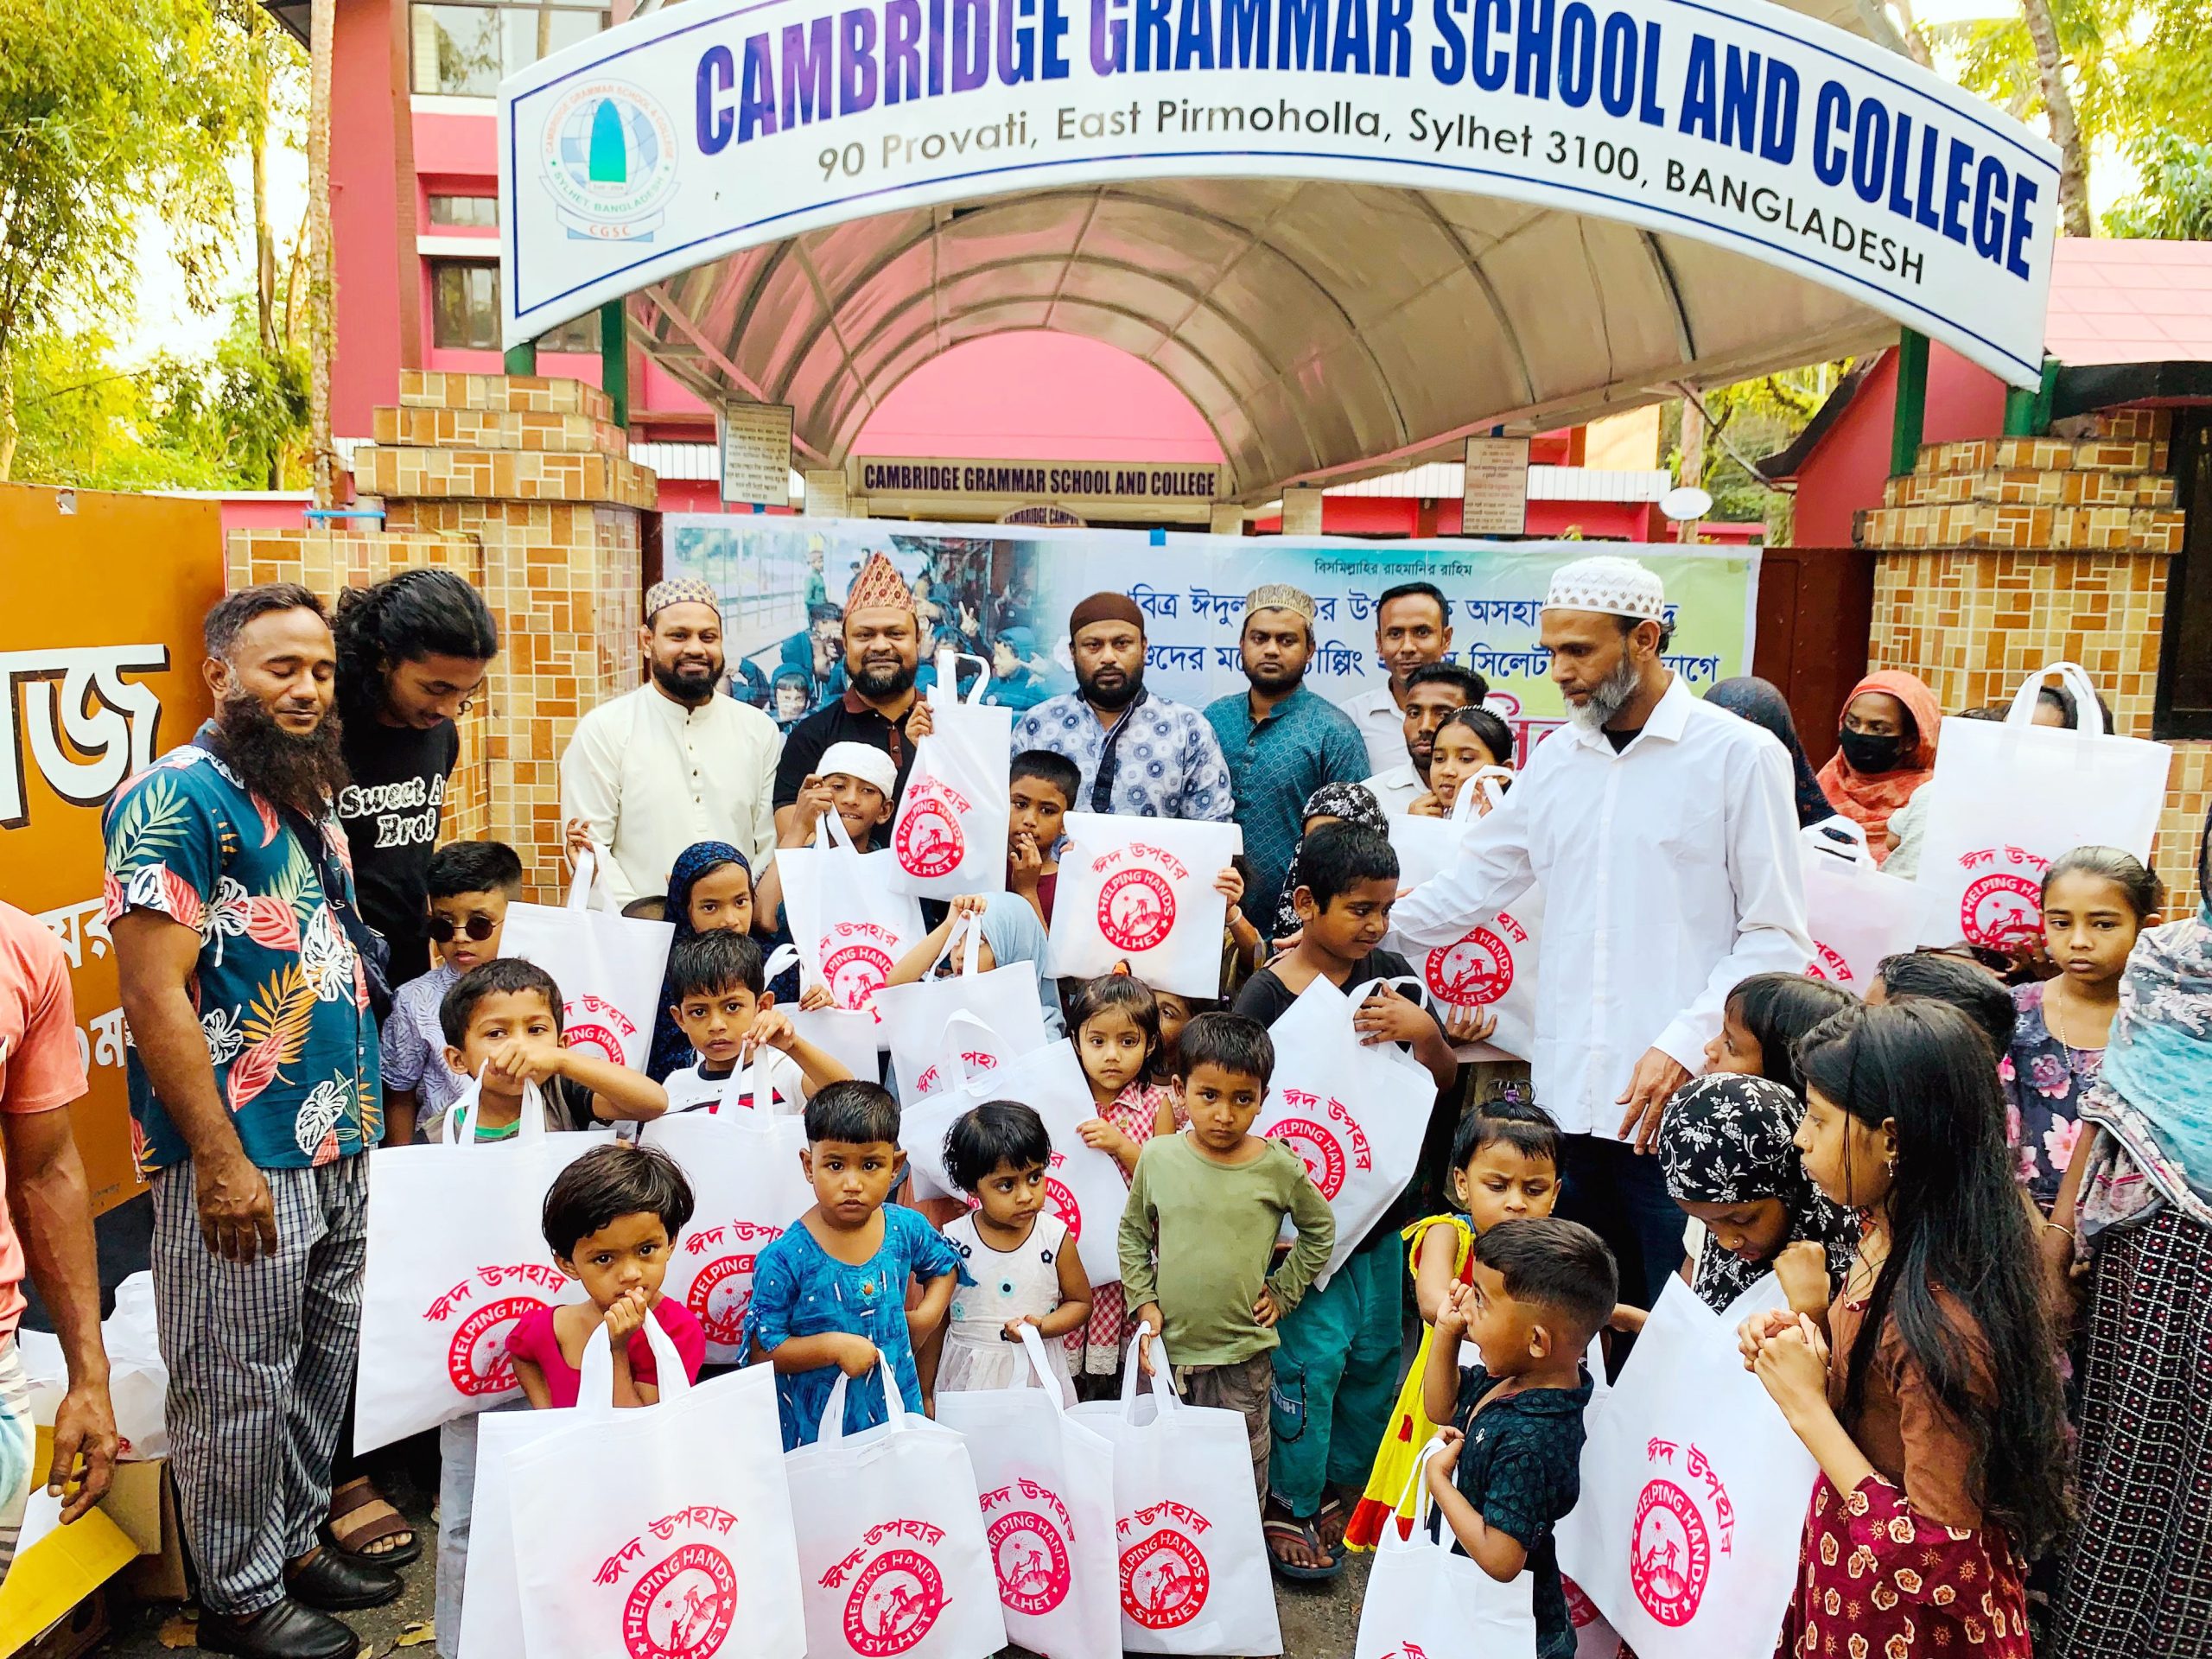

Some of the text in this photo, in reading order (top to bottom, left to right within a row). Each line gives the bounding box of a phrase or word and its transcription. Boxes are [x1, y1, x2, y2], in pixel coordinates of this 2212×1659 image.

[696, 0, 2038, 281] CAMBRIDGE GRAMMAR SCHOOL AND COLLEGE
[818, 99, 1923, 284] 90 Provati, East Pirmoholla, Sylhet 3100, BANGLADESH
[865, 464, 1216, 497] CAMBRIDGE GRAMMAR SCHOOL AND COLLEGE
[1440, 560, 1472, 577] রাহিম
[338, 776, 427, 818] Sweet
[374, 807, 436, 848] Bro!
[938, 803, 963, 848] HANDS
[899, 851, 953, 874] SYLHET
[1092, 842, 1189, 880] ঈদ উপহার
[1958, 849, 1997, 870] ঈদ
[1099, 870, 1173, 917] HELPING HANDS
[1963, 877, 2018, 912] HELPING
[835, 921, 899, 948] উপহার
[1105, 926, 1161, 949] SYLHET
[1478, 931, 1511, 980] HANDS
[582, 994, 638, 1037] উপহার
[1434, 984, 1496, 1003] SYLHET
[1283, 1089, 1372, 1174] ঈদ উপহার
[1322, 1139, 1343, 1197] HANDS
[685, 1226, 726, 1255] ঈদ
[423, 1262, 569, 1322] ঈদ উপহার
[691, 1257, 750, 1306] HELPING
[453, 1303, 507, 1372] HELPING
[1135, 1500, 1212, 1535] উপহার
[1648, 1436, 1735, 1559] ঈদ উপহার
[593, 1505, 739, 1586] ঈদ উপহার
[818, 1518, 947, 1589] ঈদ উপহার
[1120, 1533, 1206, 1592] HELPING HANDS
[1636, 1484, 1707, 1600] HELPING HANDS
[628, 1549, 734, 1639] HELPING HANDS
[848, 1554, 938, 1631] HELPING HANDS
[1631, 1550, 1680, 1621] SYLHET
[862, 1611, 932, 1652] SYLHET
[1132, 1594, 1199, 1625] SYLHET
